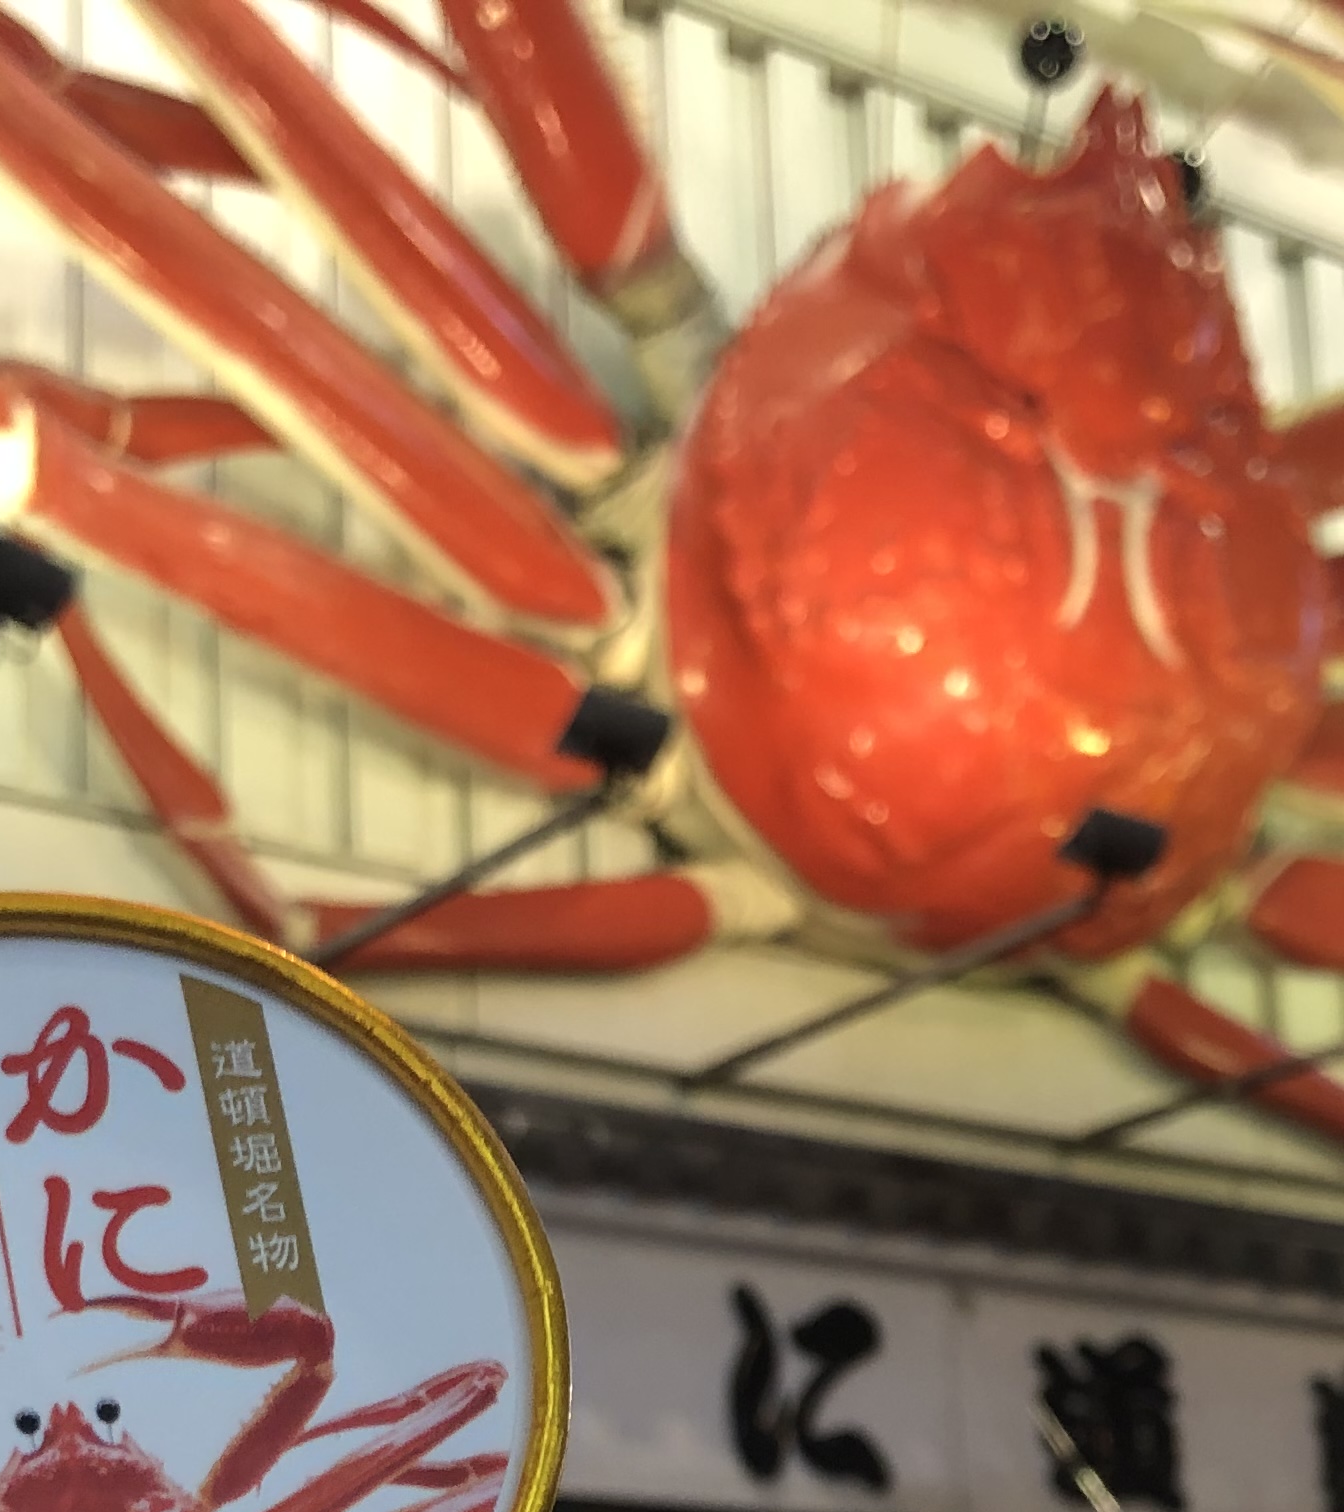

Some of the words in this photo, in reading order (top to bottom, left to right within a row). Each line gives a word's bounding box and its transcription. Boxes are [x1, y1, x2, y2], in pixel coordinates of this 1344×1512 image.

[1, 1005, 209, 1314] かに
[210, 1038, 300, 1274] 道頓堀名物
